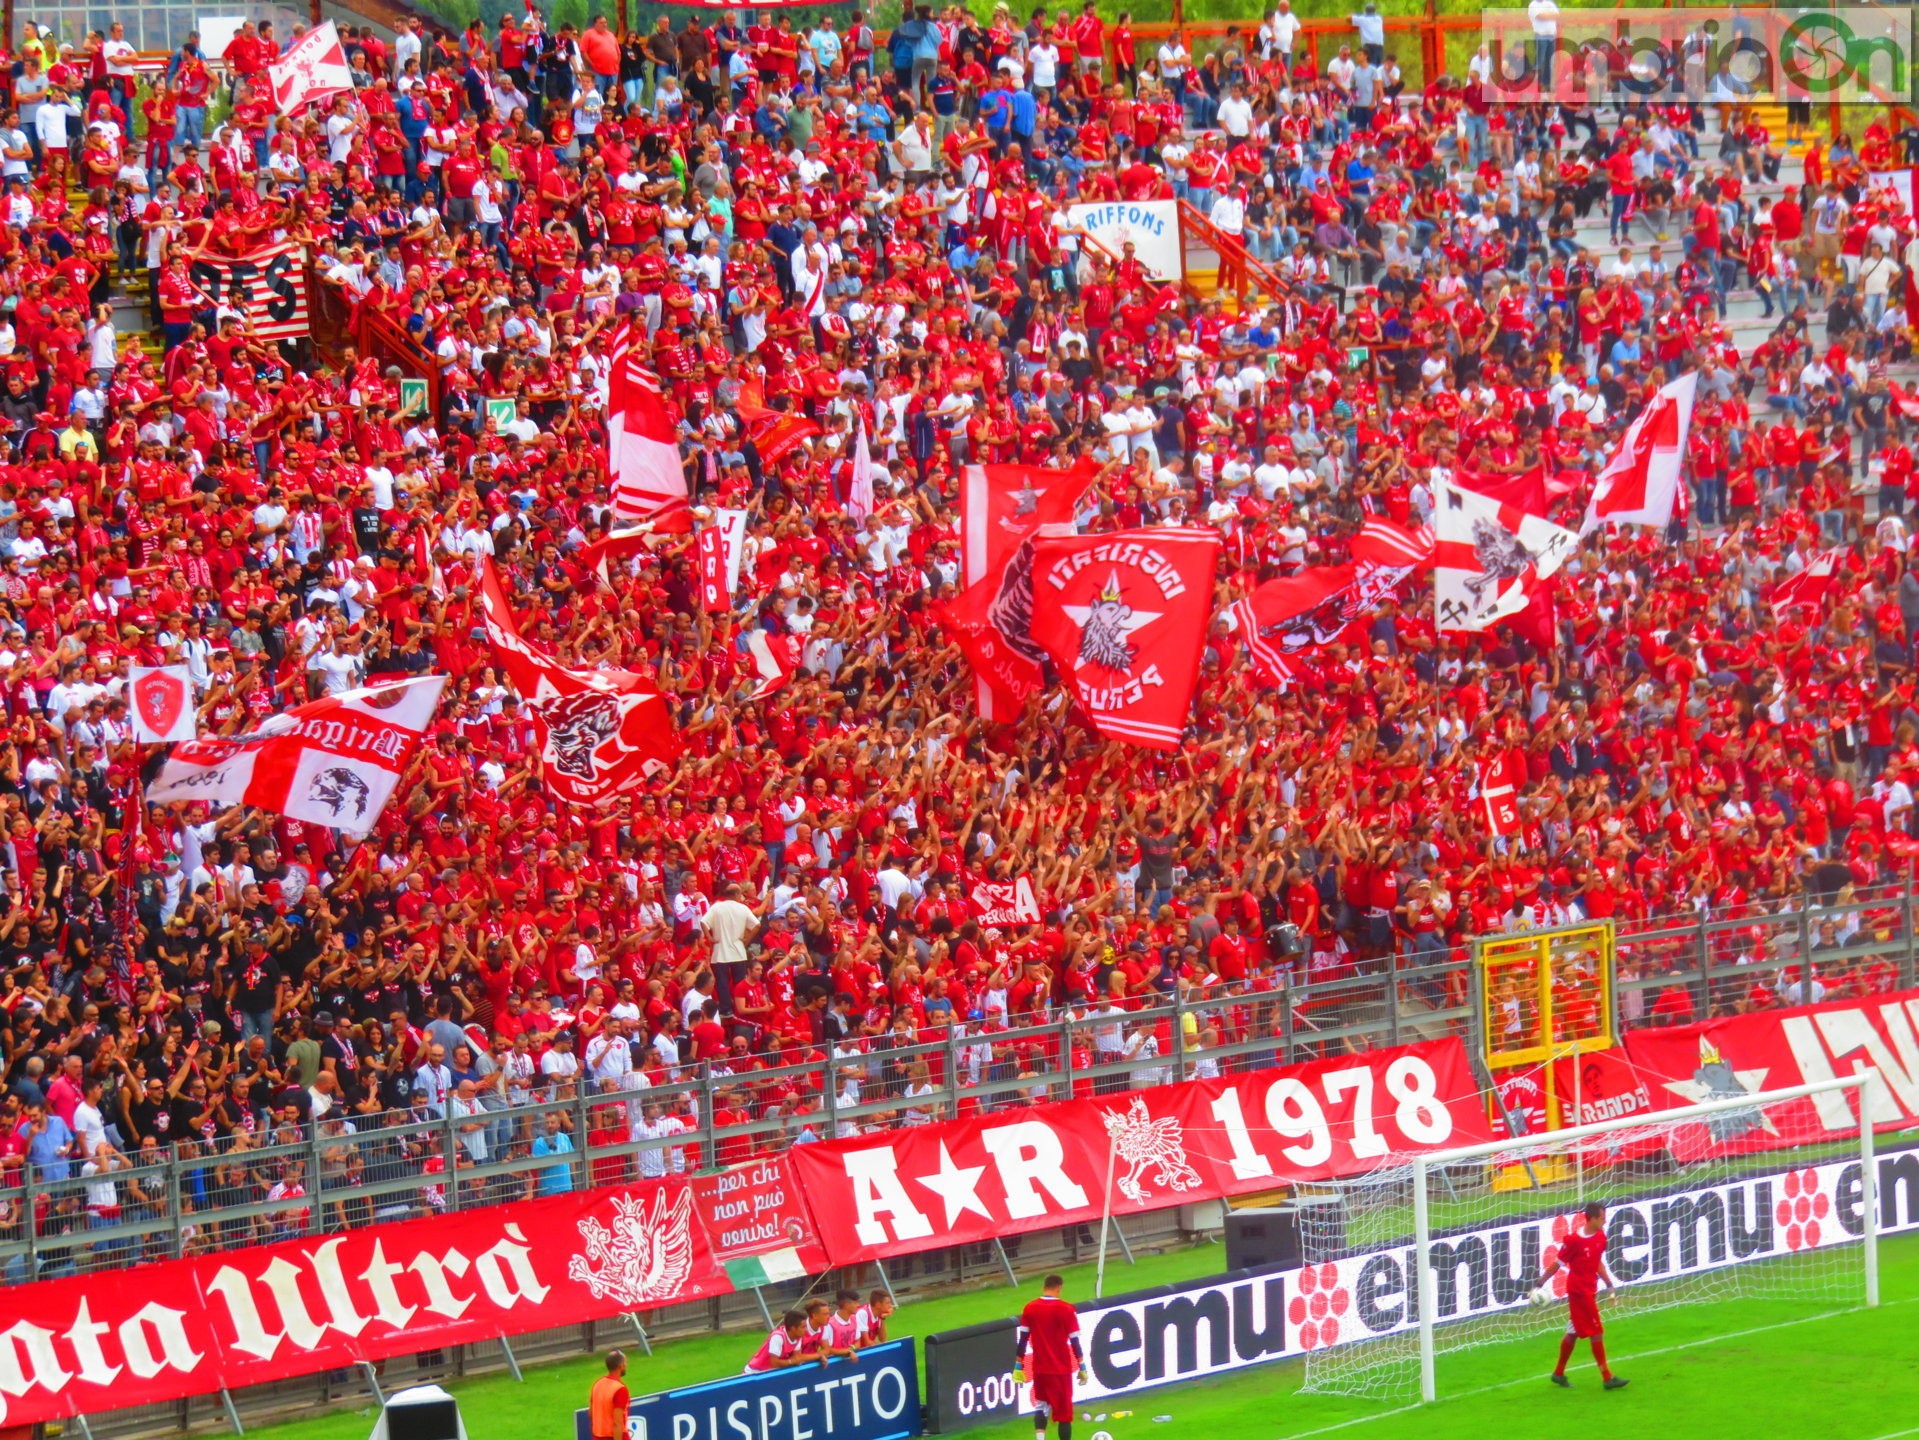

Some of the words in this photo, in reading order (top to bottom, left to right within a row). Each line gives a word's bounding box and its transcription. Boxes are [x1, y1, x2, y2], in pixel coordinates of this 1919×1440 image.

[1085, 205, 1164, 236] RIFFONS
[1211, 1055, 1453, 1180] 1978
[713, 1199, 749, 1221] non
[753, 1185, 785, 1218] può
[752, 1160, 781, 1186] chi
[721, 1213, 780, 1247] venire!
[1606, 1181, 1775, 1282] emu
[1356, 1226, 1541, 1332] emu
[0, 1295, 205, 1424] ata
[206, 1222, 551, 1361] Ultrà
[1090, 1277, 1286, 1390] emu
[958, 1372, 1015, 1415] 0:00
